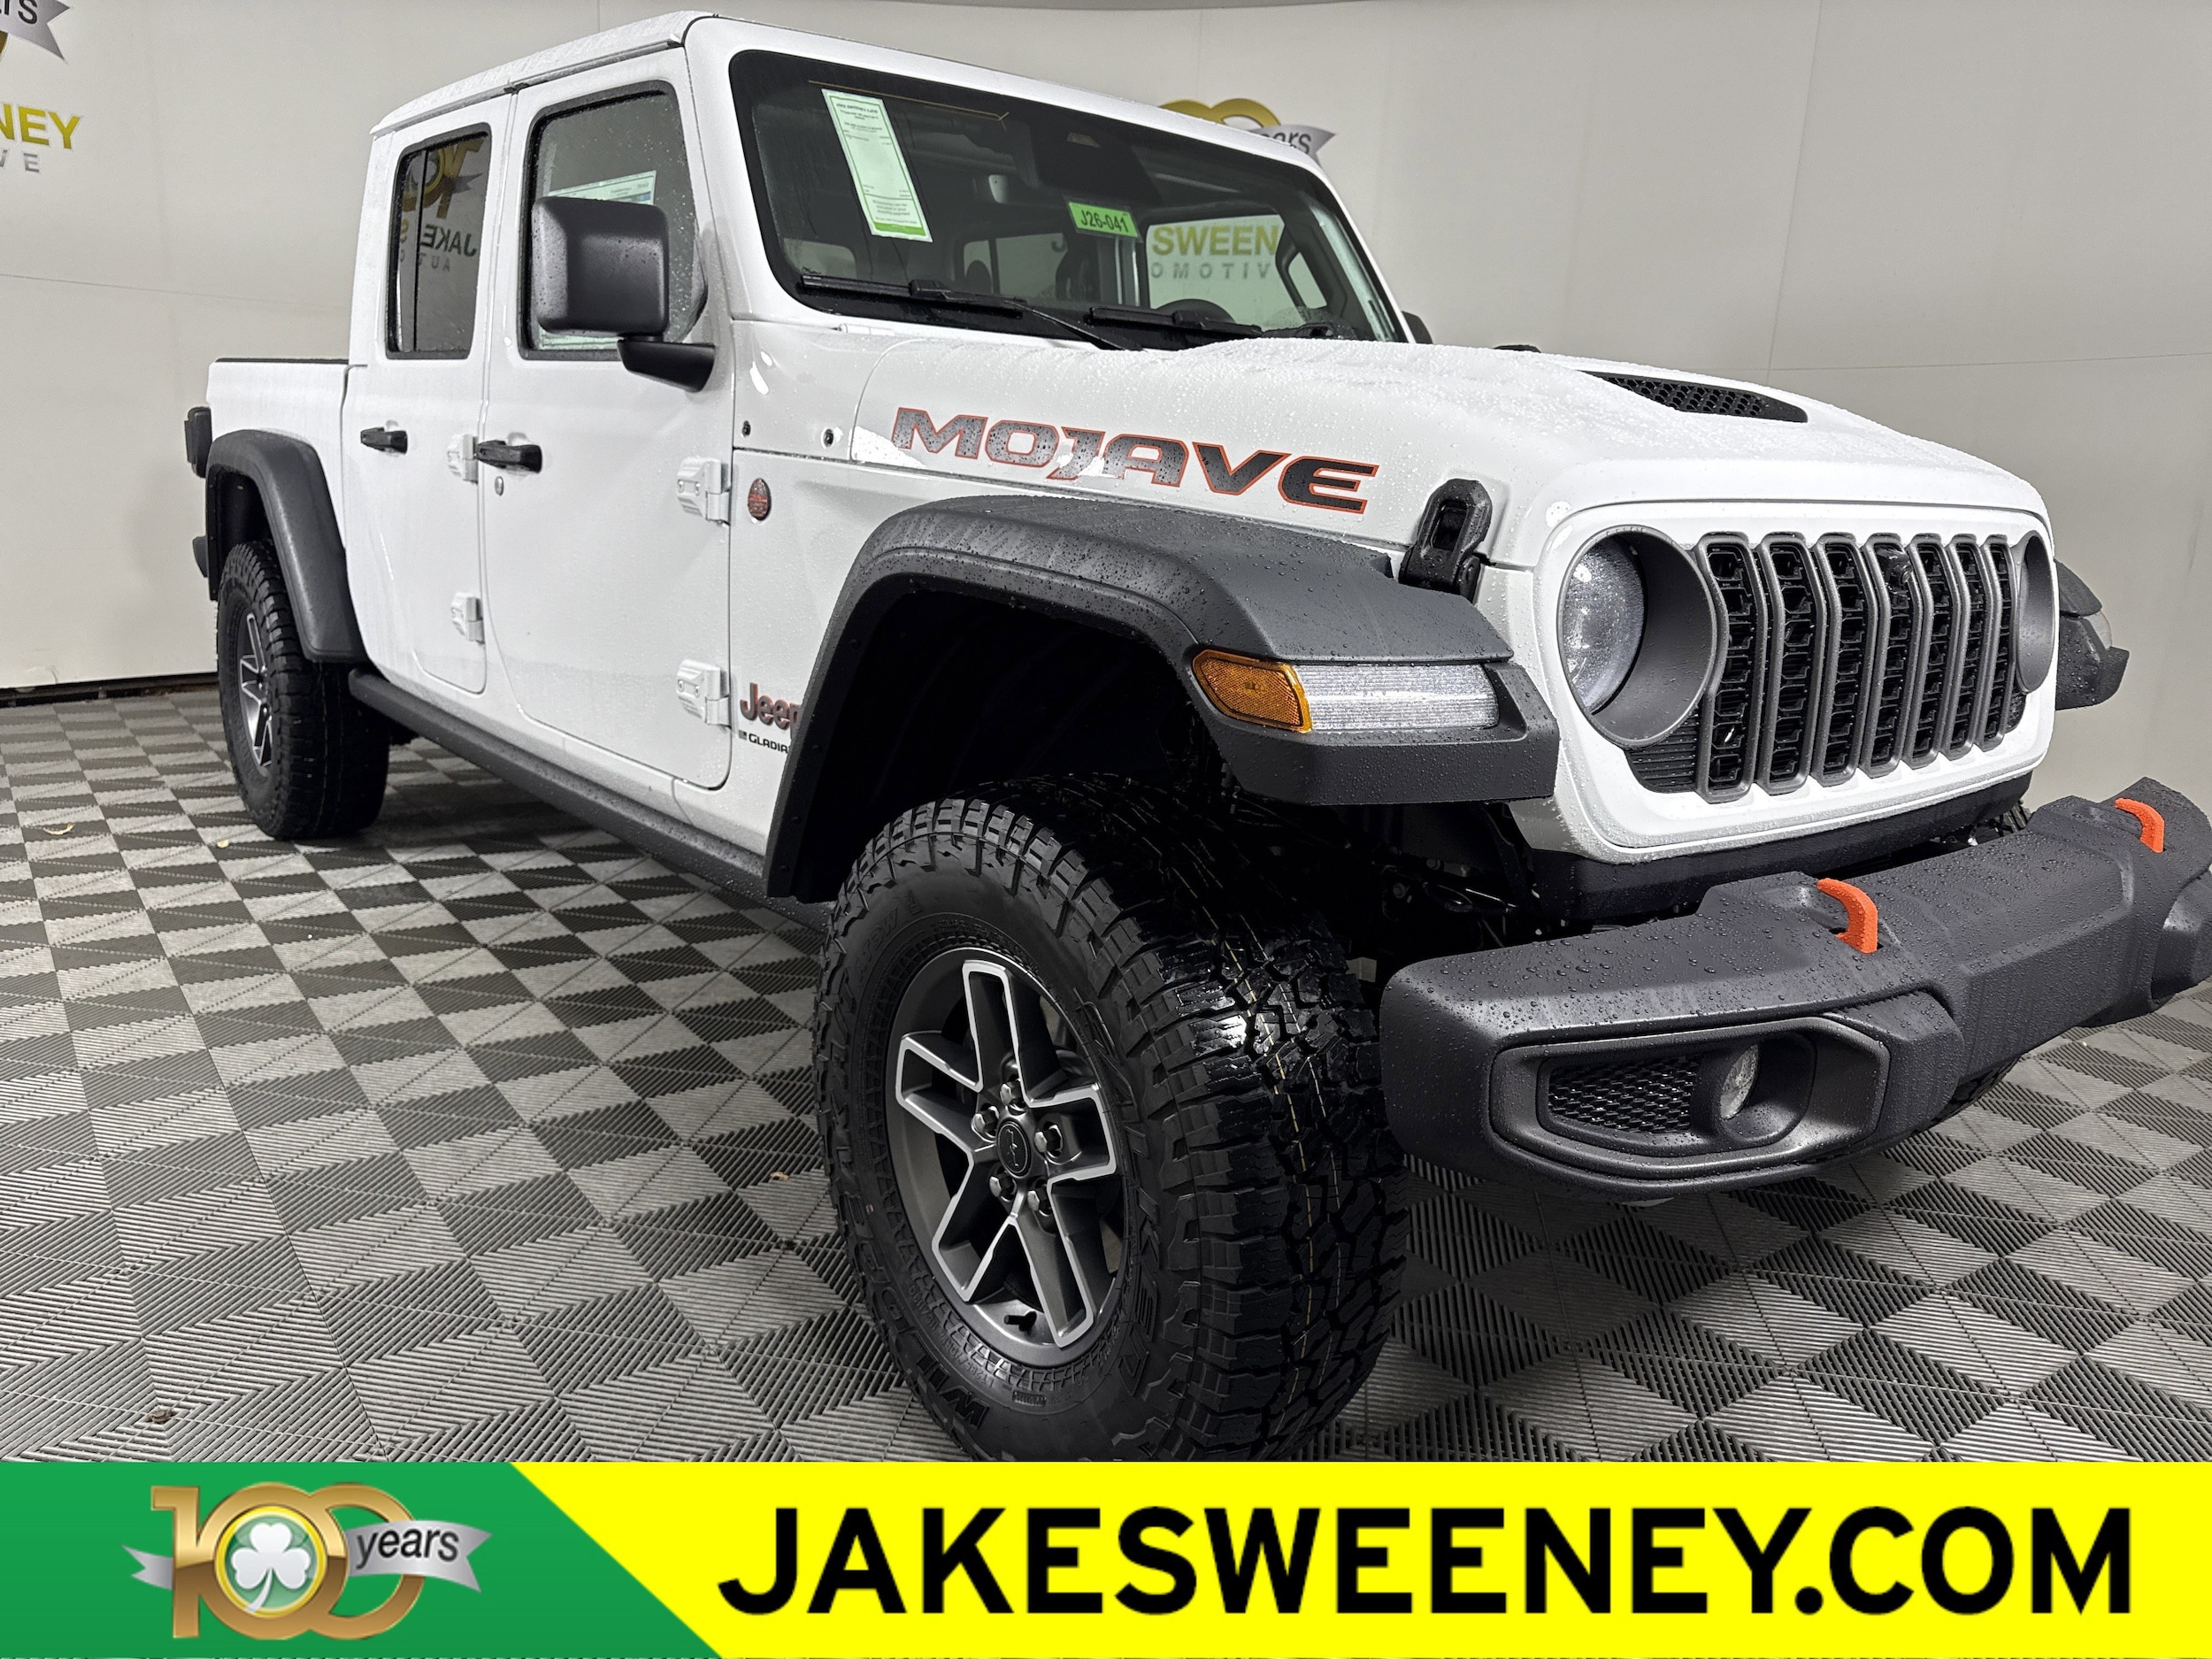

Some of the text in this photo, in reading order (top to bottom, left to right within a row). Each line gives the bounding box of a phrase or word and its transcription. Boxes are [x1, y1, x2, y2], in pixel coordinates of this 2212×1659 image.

[1080, 210, 1129, 233] J26-041
[892, 407, 1379, 514] MOJAVE
[749, 733, 790, 754] GLADIA
